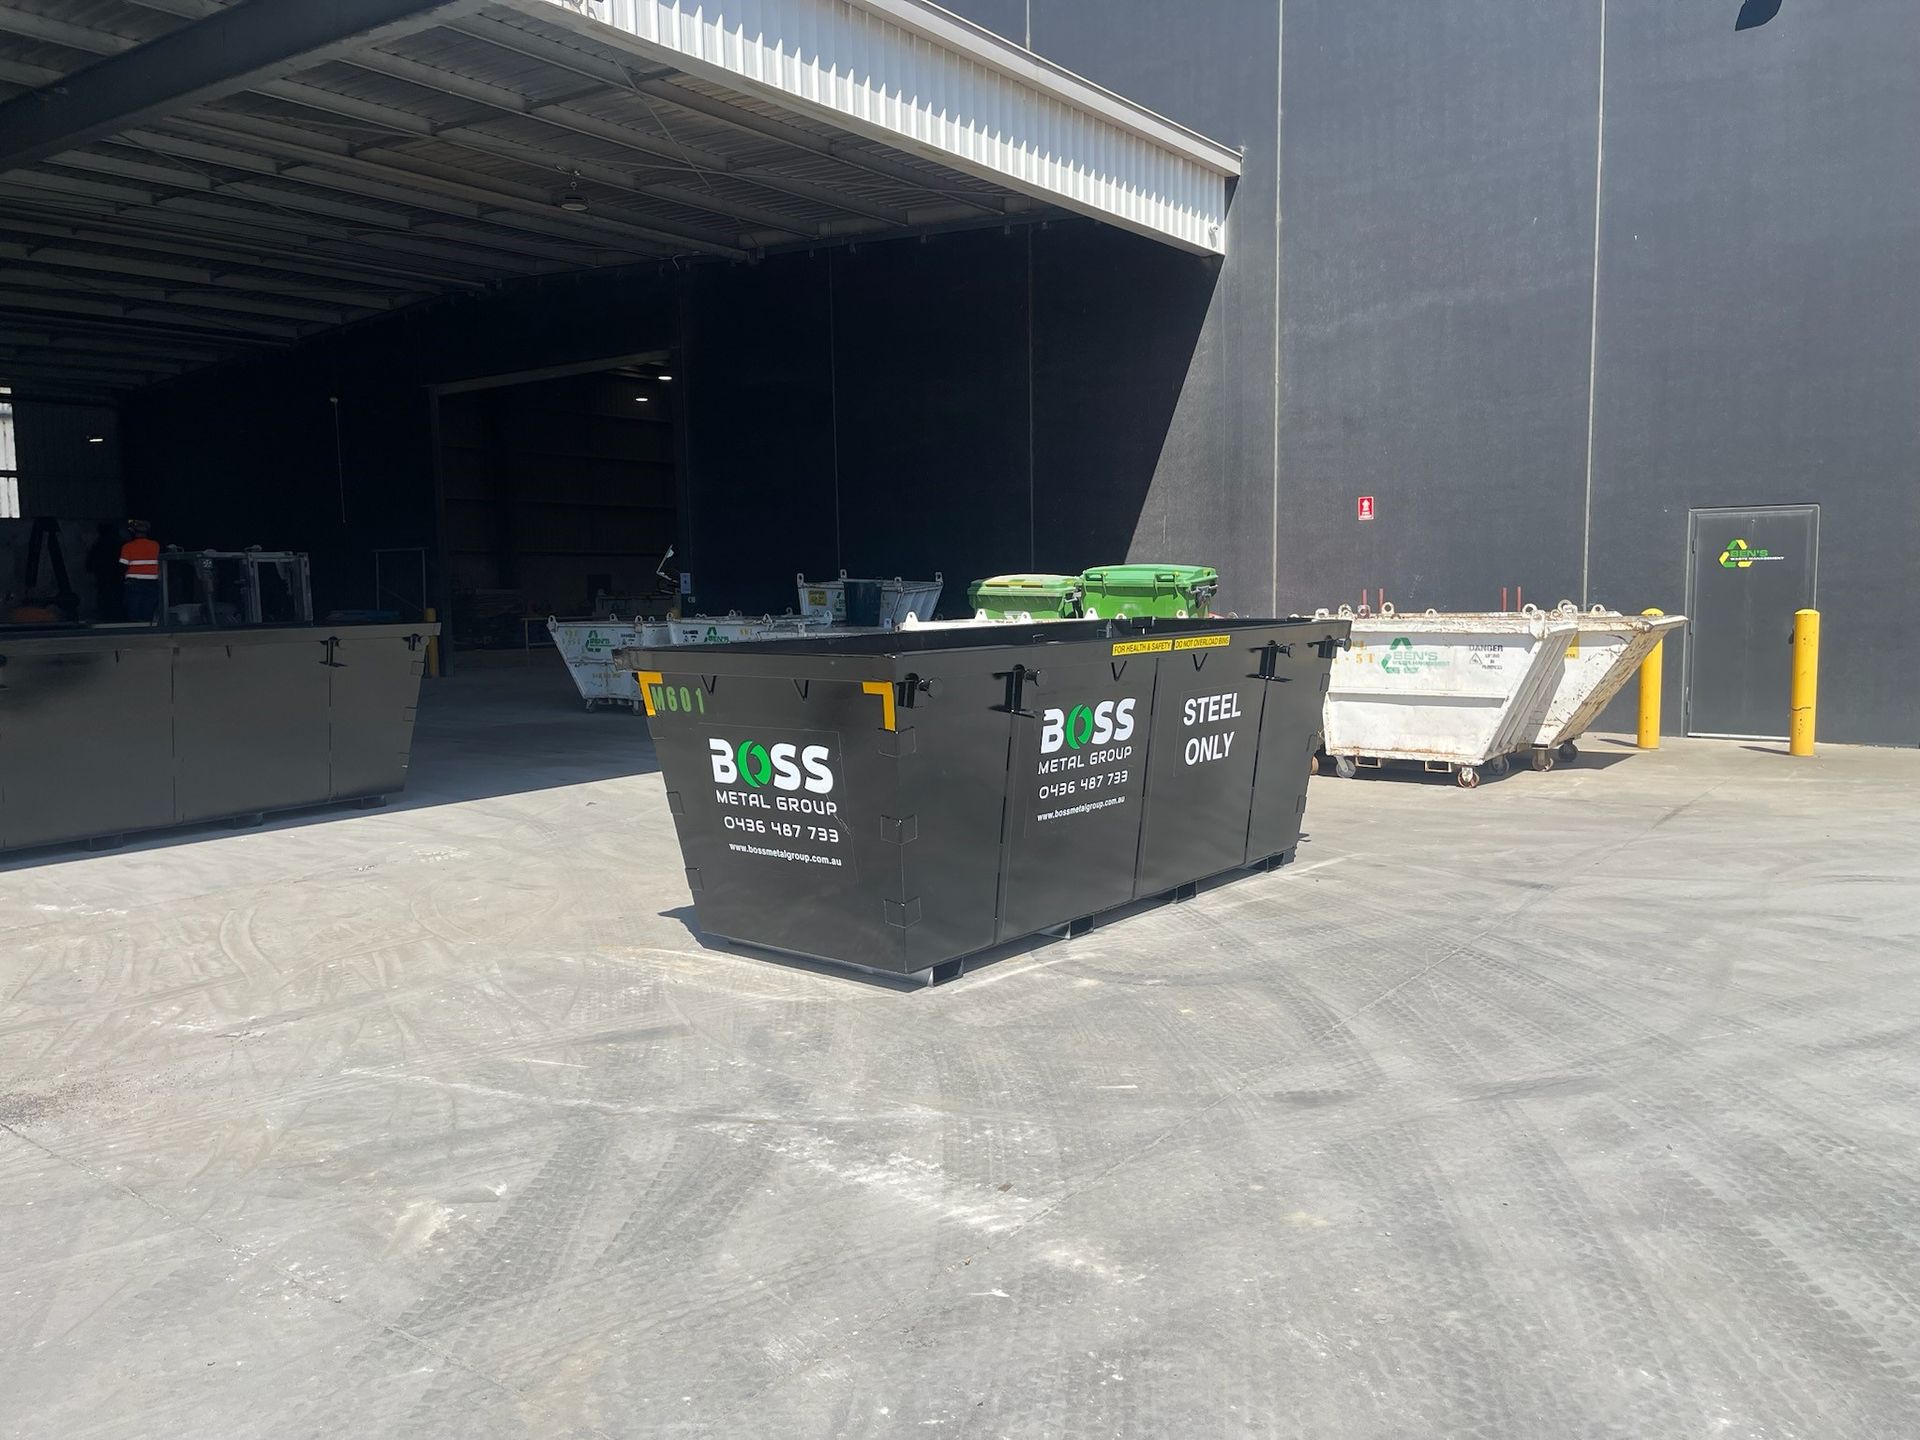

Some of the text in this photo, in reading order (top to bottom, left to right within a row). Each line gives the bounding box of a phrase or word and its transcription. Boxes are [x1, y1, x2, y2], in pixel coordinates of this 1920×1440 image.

[1730, 549, 1768, 557] BEN'S
[1114, 644, 1126, 653] FOR
[1126, 643, 1146, 652] HEALTH
[1151, 641, 1171, 651] SAFETY
[1175, 640, 1183, 649] DO
[1183, 639, 1193, 648] NOT
[1194, 637, 1218, 647] OVERLOAD
[1393, 651, 1438, 660] BEN'S
[1469, 644, 1503, 652] DANGER
[650, 685, 704, 714] M601
[1183, 692, 1242, 727] STEEL
[1041, 698, 1136, 754] BOSS
[1037, 746, 1132, 775] METAL GROUP
[1185, 731, 1235, 766] ONLY
[708, 738, 834, 794] BOSS
[1039, 770, 1128, 799] 0436 487 733
[716, 790, 838, 816] METAL GROUP
[1037, 794, 1126, 822] www.bossmetalgroup.com.au
[724, 816, 839, 843] 0436 487 733
[729, 842, 842, 866] www.bossmetalgroup.com.au
